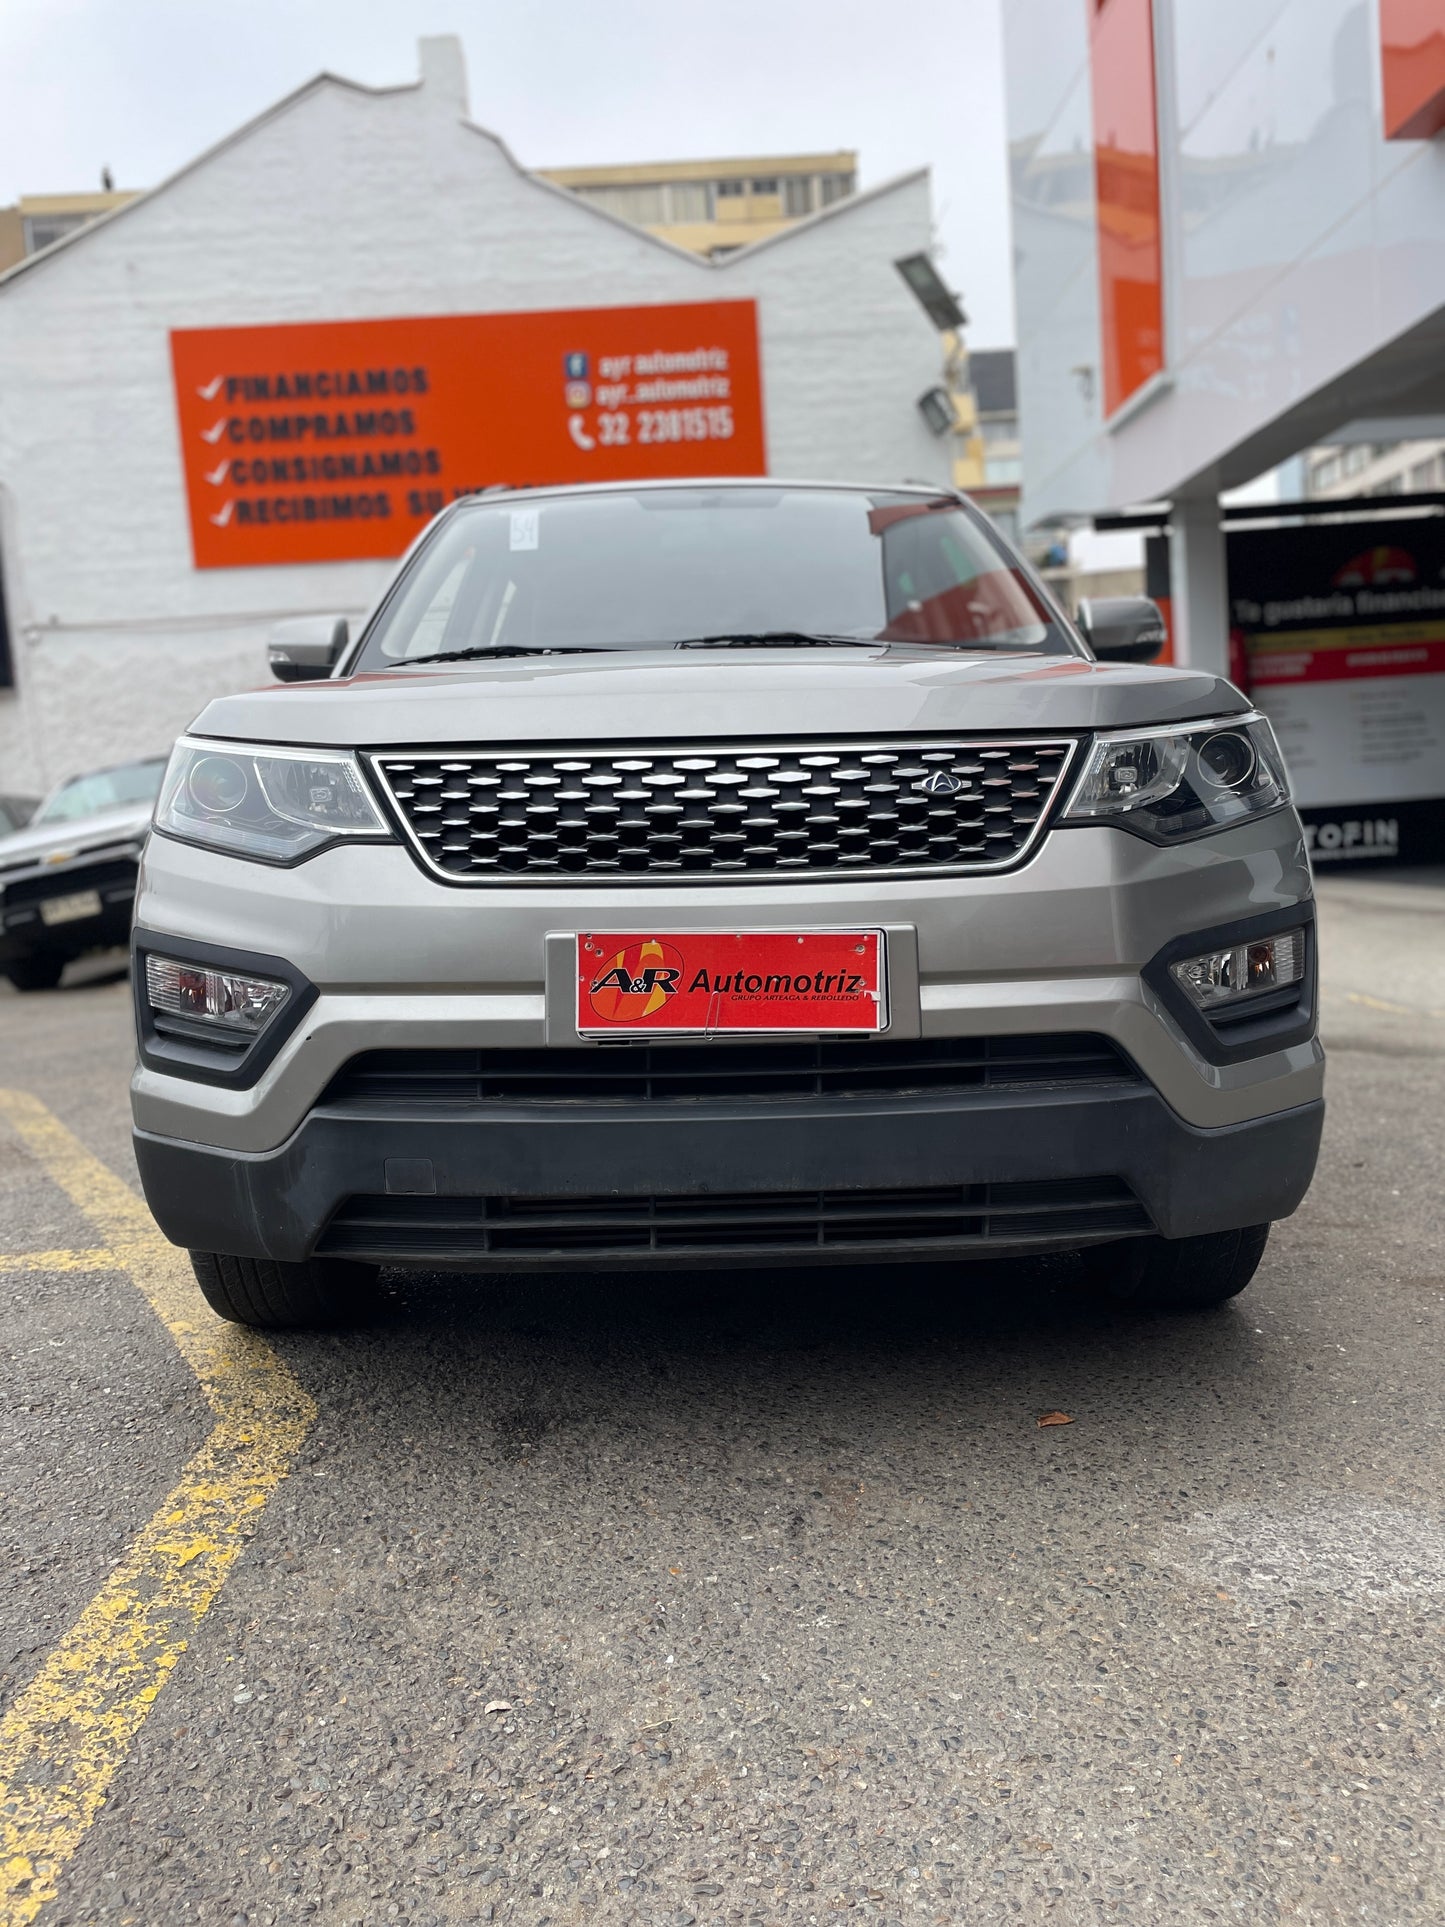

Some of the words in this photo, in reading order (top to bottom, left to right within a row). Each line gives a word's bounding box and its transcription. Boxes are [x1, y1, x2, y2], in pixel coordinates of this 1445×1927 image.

[225, 366, 430, 402] FINANCIAMOS
[227, 409, 417, 443] COMPRAMOS
[598, 412, 630, 445] 32
[231, 448, 442, 485] CONSIGNAMOS
[235, 492, 391, 525] RECIBIMOS
[407, 488, 445, 517] SU
[1303, 819, 1399, 848] TOFIN
[589, 968, 680, 994] A&R
[688, 968, 862, 993] Automotriz
